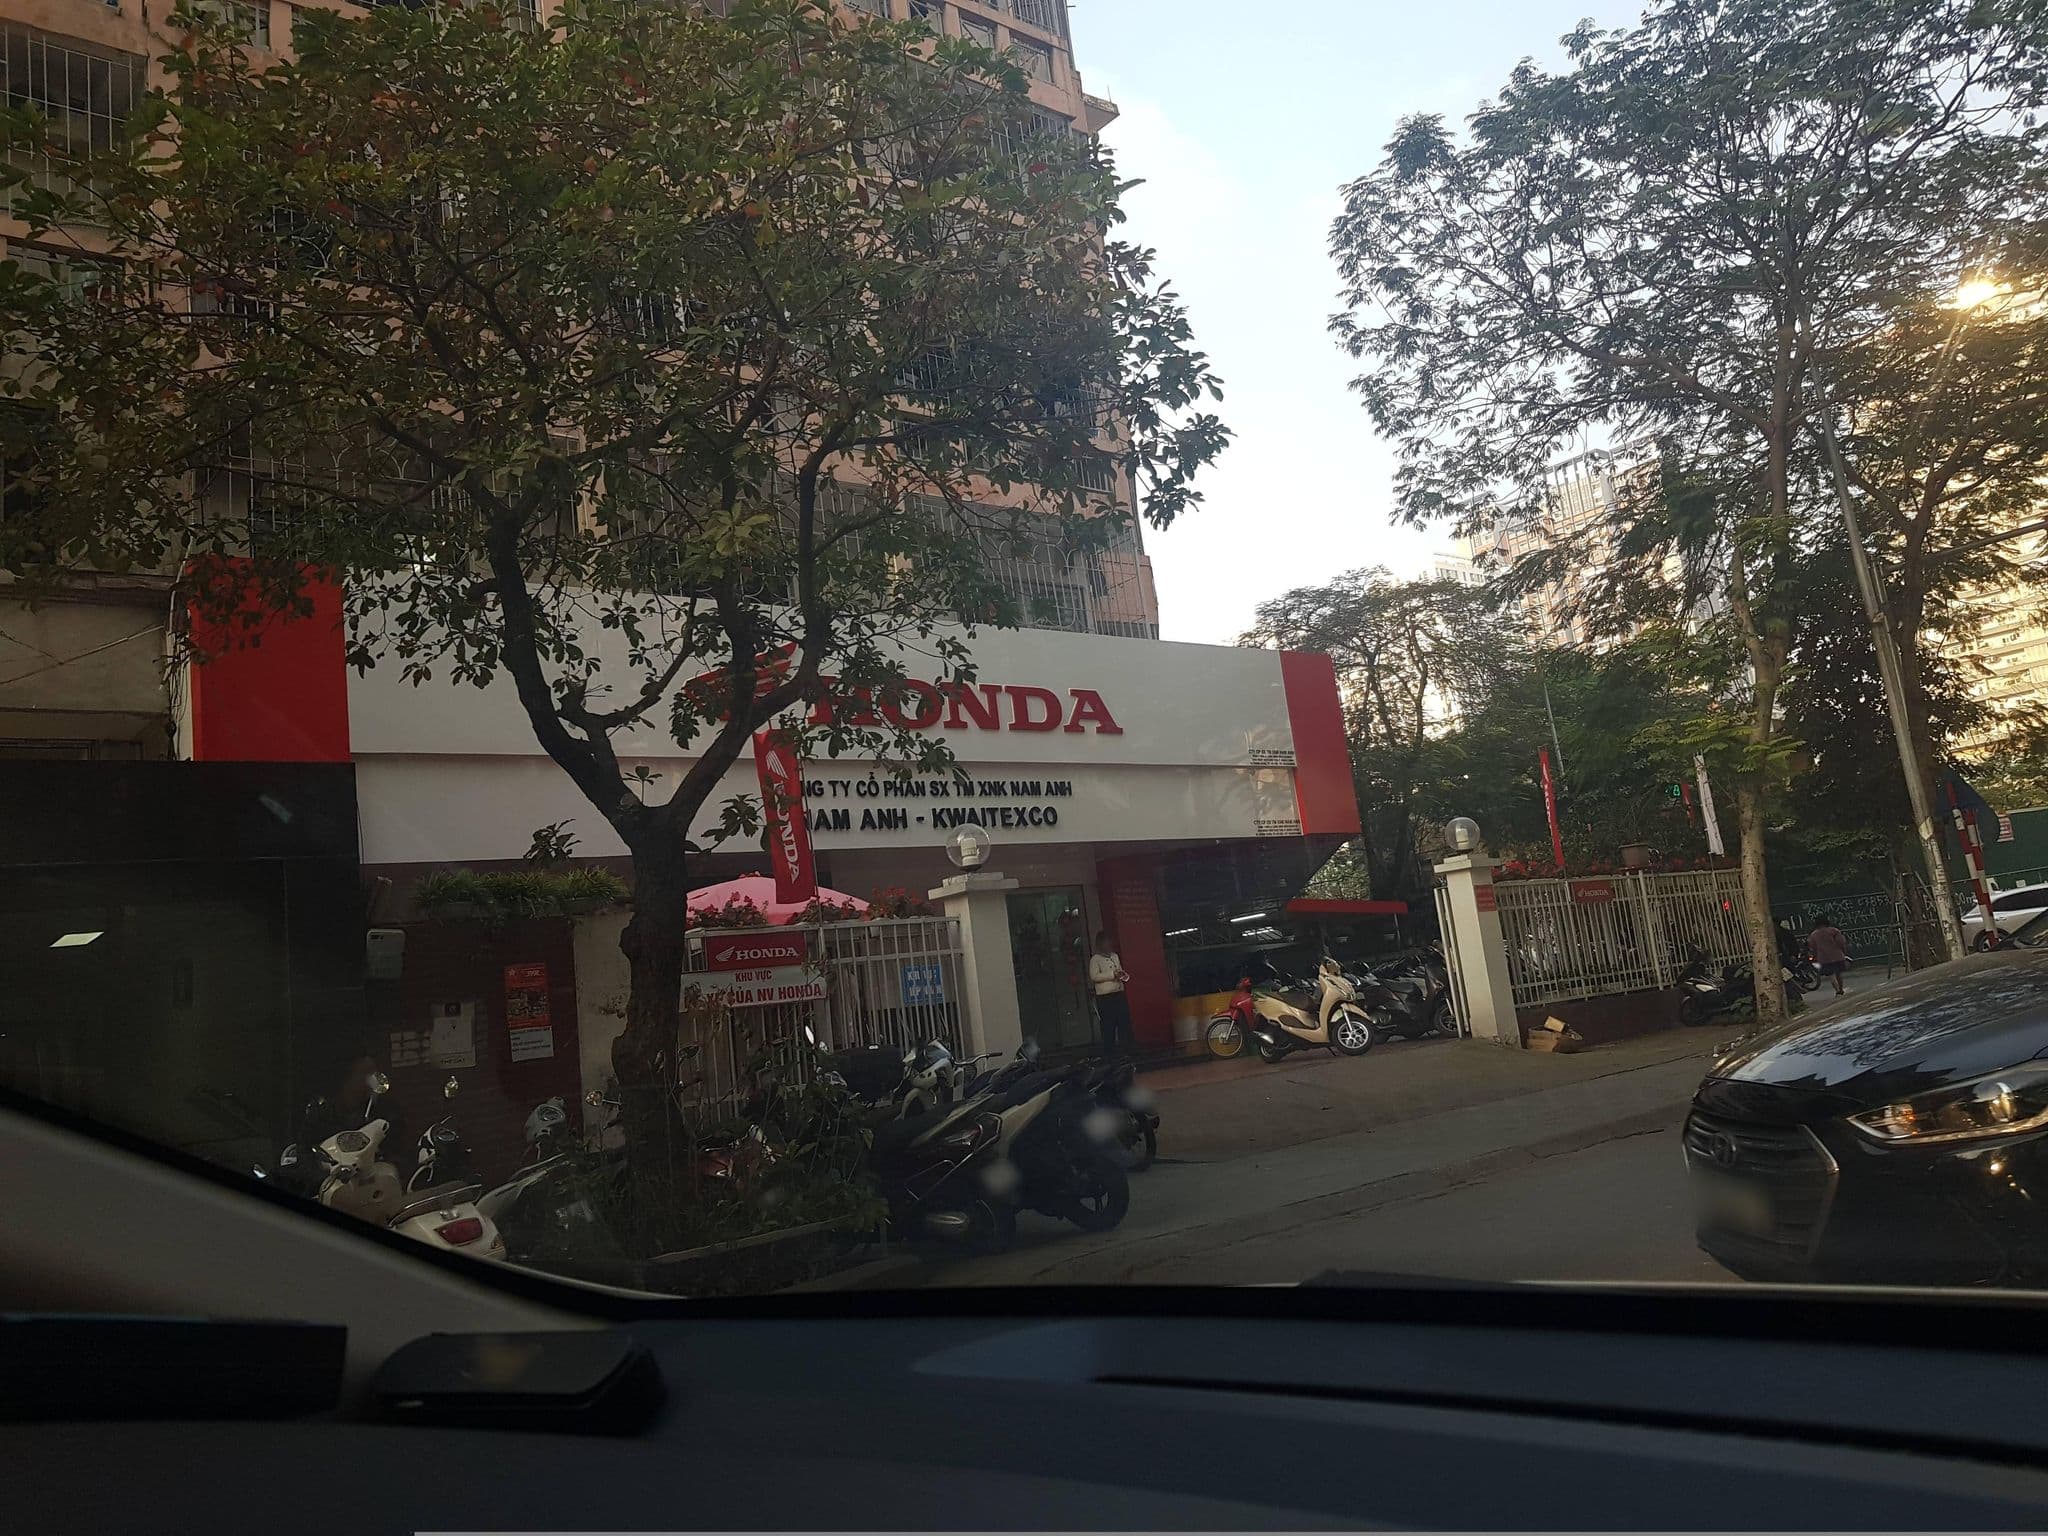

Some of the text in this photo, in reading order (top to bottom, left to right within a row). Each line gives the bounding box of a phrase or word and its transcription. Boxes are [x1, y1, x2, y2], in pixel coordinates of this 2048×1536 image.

[807, 675, 1124, 735] HONDA
[800, 781, 824, 798] NG
[828, 780, 851, 797] TY
[929, 779, 950, 798] SX
[953, 780, 975, 797] TM
[978, 780, 1007, 797] XNK
[1011, 780, 1041, 797] NAM
[1045, 780, 1072, 797] ANH
[860, 807, 908, 831] ANH
[932, 805, 1058, 829] KWAITEXCO
[735, 946, 800, 961] HONDA
[735, 971, 753, 983] KHU
[757, 987, 774, 1002] NV
[778, 983, 822, 1000] HONDA
